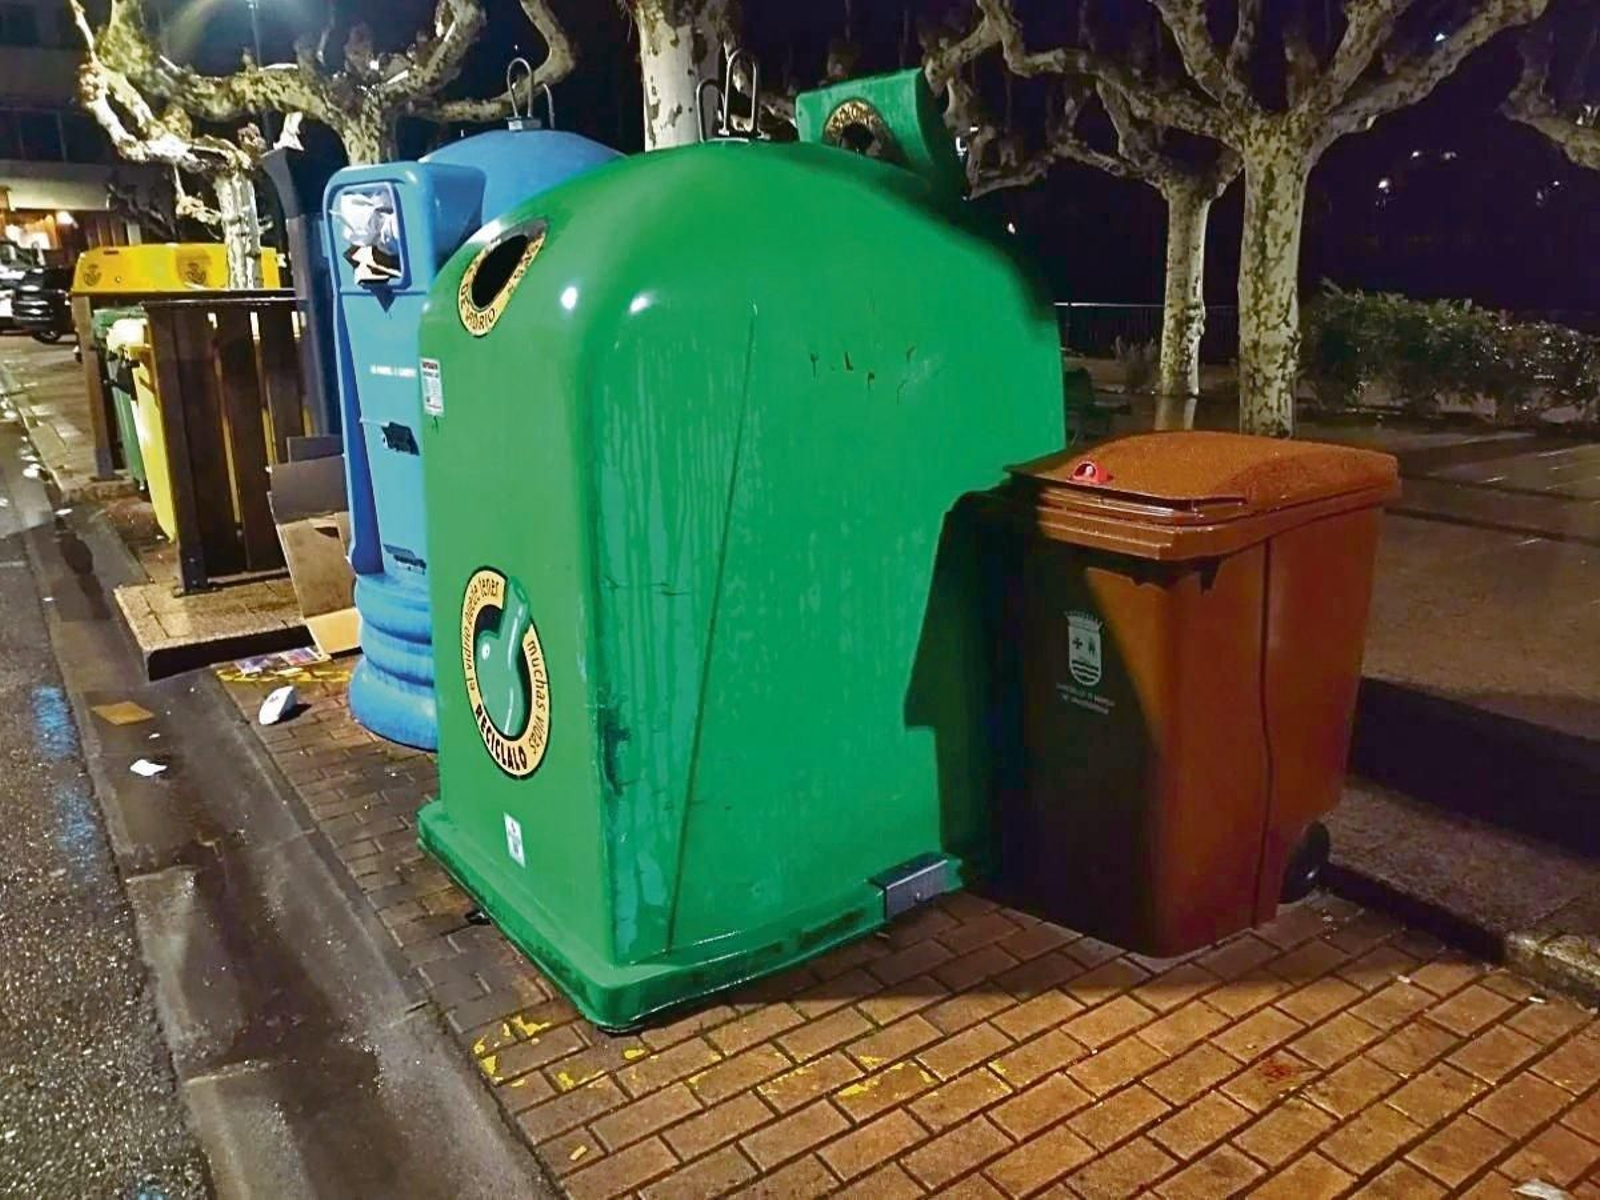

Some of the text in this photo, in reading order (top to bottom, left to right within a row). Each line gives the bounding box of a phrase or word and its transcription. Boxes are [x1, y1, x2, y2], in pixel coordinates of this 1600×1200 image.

[463, 627, 474, 671] vidrio
[479, 577, 500, 600] tener
[527, 640, 548, 712] muchas
[474, 702, 528, 771] RECICLALO
